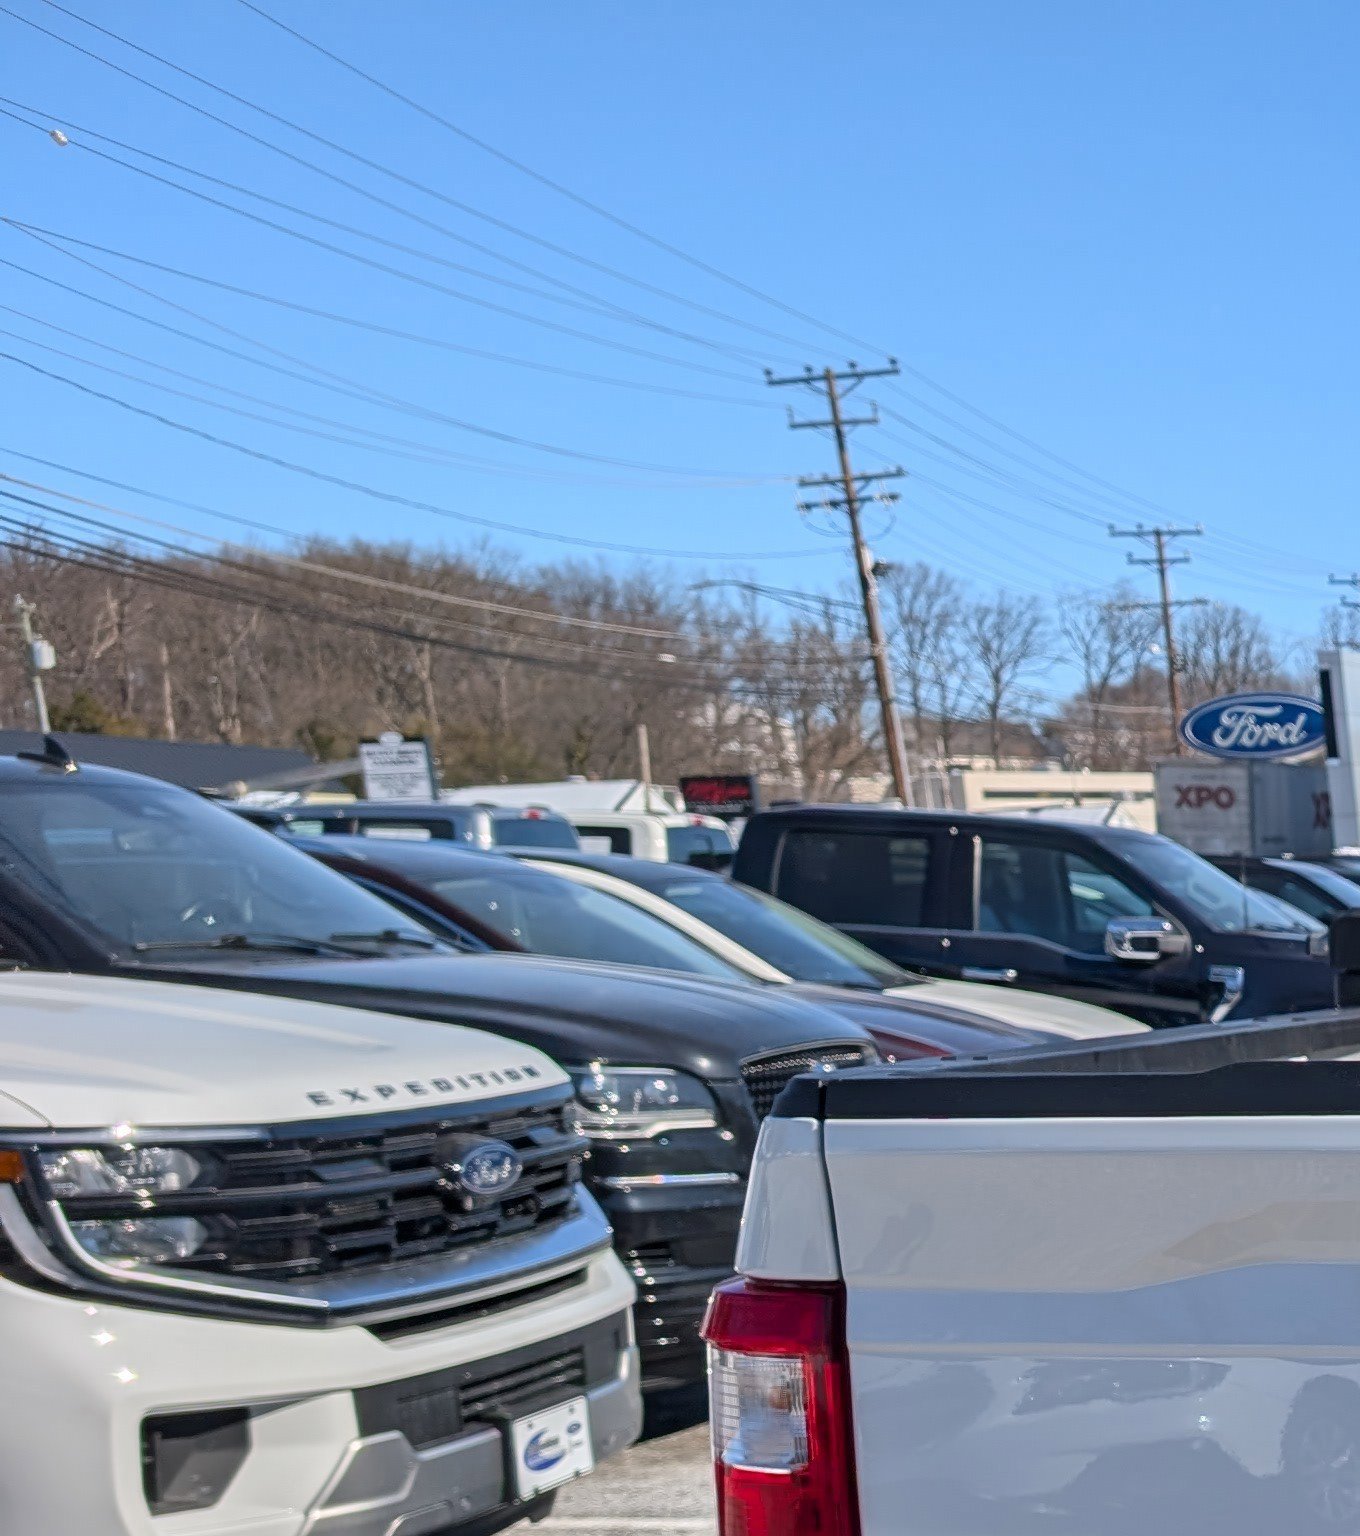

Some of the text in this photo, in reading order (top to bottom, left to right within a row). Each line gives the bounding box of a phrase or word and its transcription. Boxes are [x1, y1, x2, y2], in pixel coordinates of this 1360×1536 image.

[1212, 704, 1307, 748] Ford
[1174, 783, 1236, 810] XPO
[306, 1064, 541, 1107] EXPEDITION
